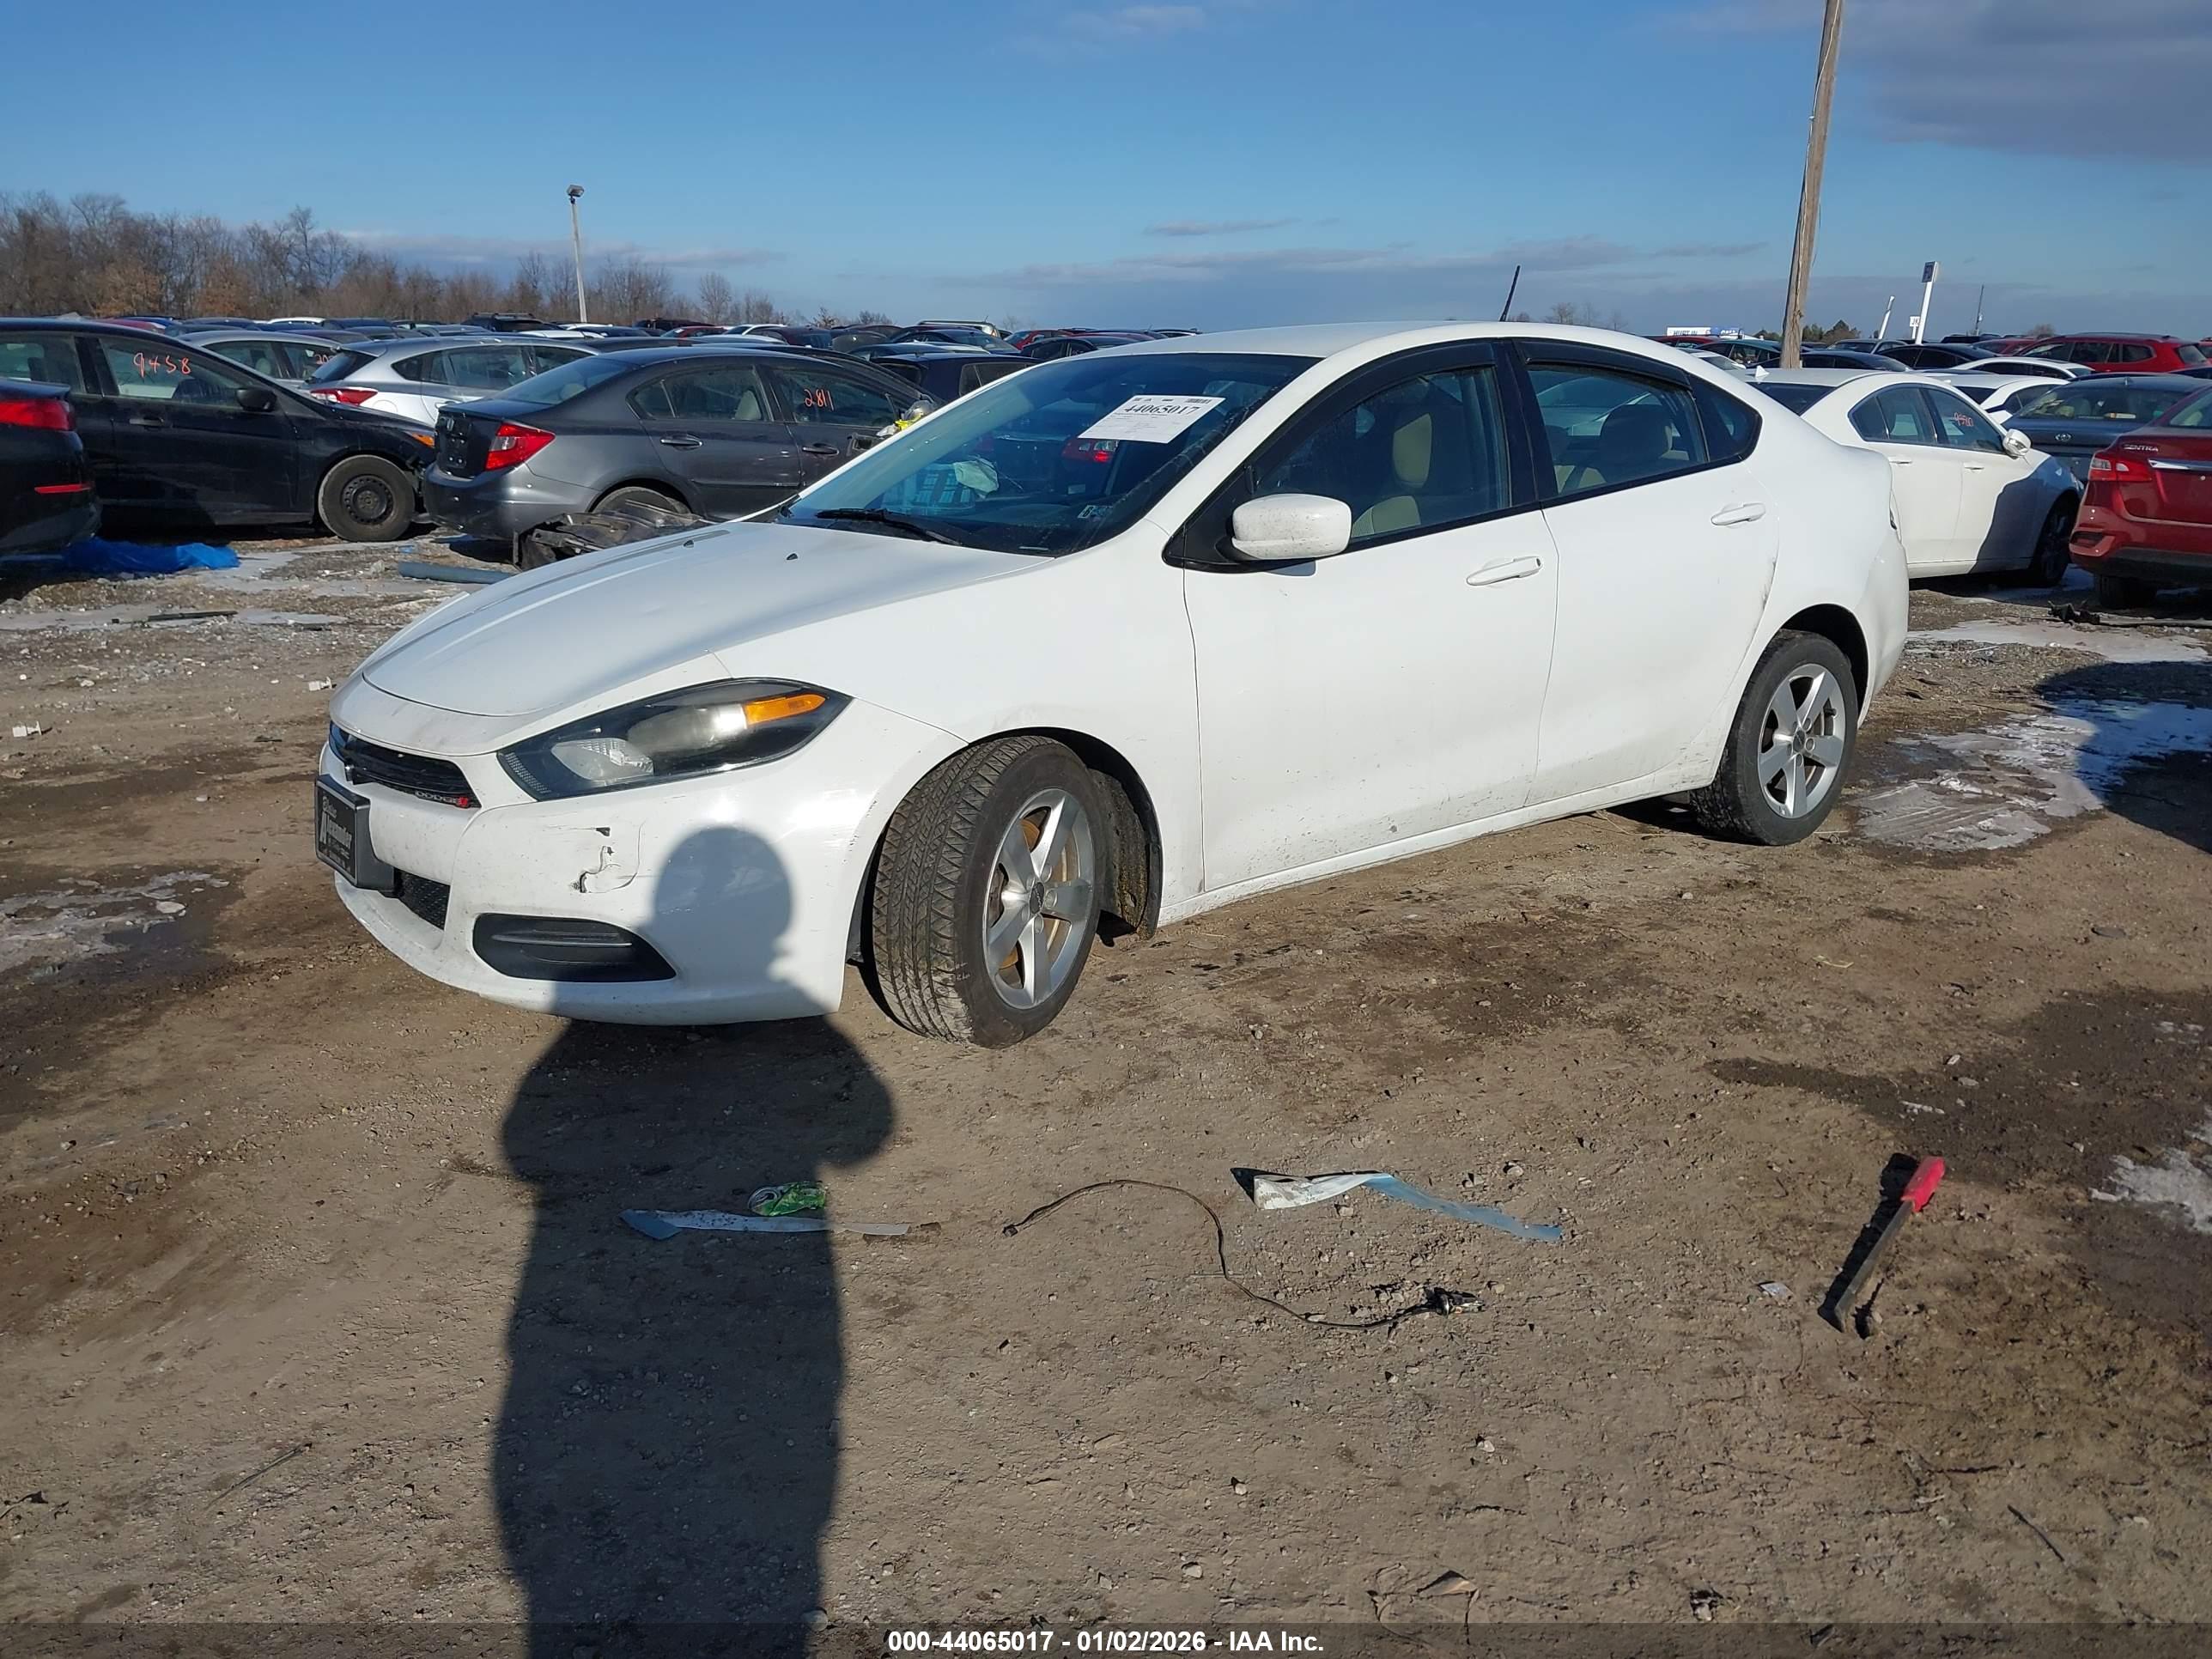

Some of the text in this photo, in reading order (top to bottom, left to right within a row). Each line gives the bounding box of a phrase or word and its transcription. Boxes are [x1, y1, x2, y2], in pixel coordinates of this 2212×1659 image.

[133, 352, 191, 378] 9458
[1123, 404, 1200, 416] 44065017
[414, 790, 459, 804] DODGE
